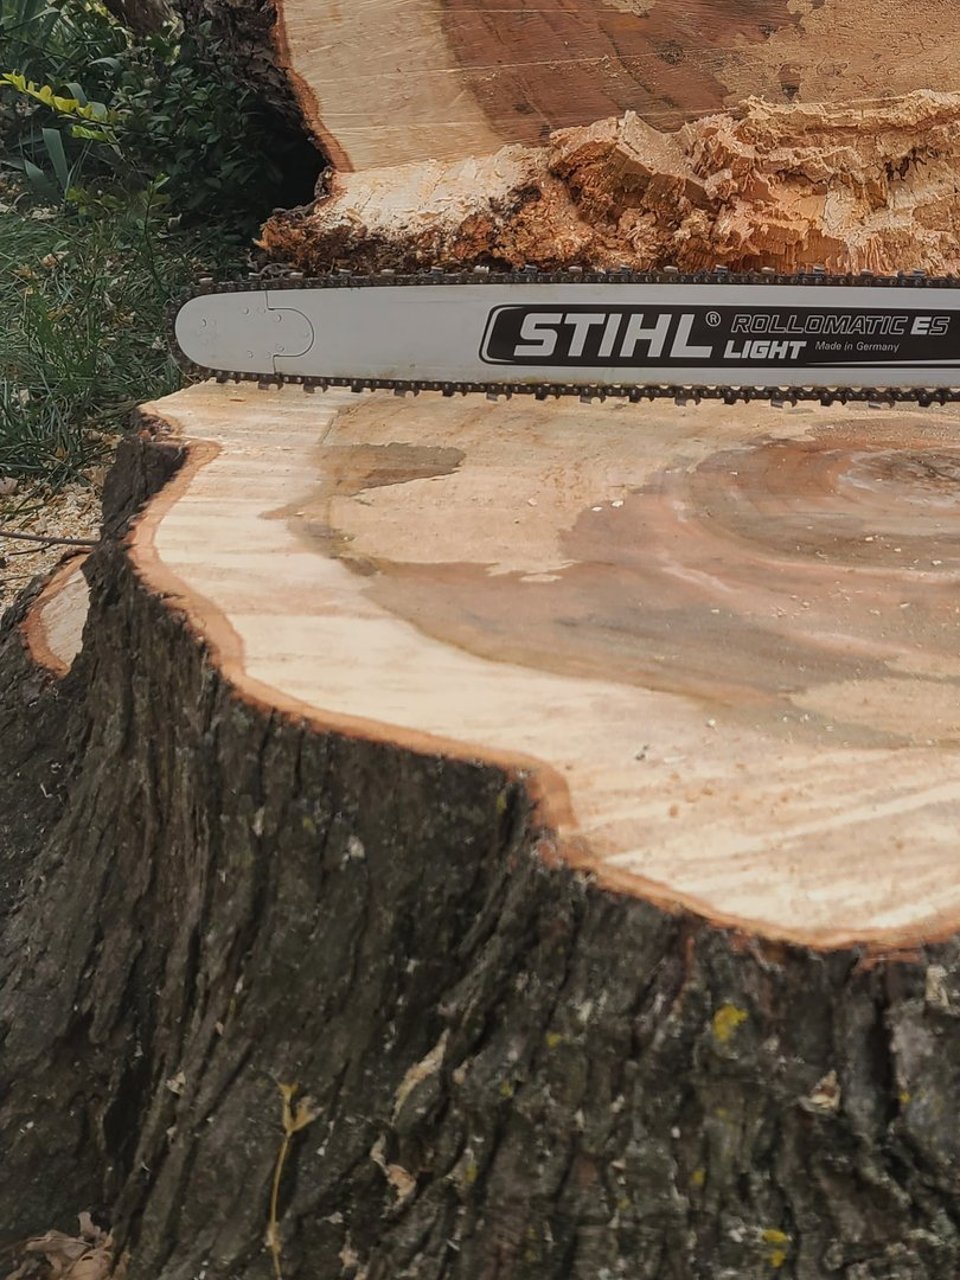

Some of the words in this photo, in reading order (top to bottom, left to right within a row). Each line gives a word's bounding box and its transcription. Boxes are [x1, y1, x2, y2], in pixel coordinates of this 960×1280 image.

[731, 314, 908, 335] ROLLOMATIC
[910, 316, 950, 336] ES
[513, 313, 713, 358] STIHL
[723, 340, 807, 359] LIGHT
[815, 340, 842, 352] Made
[844, 341, 853, 352] in
[856, 341, 900, 354] Germany
